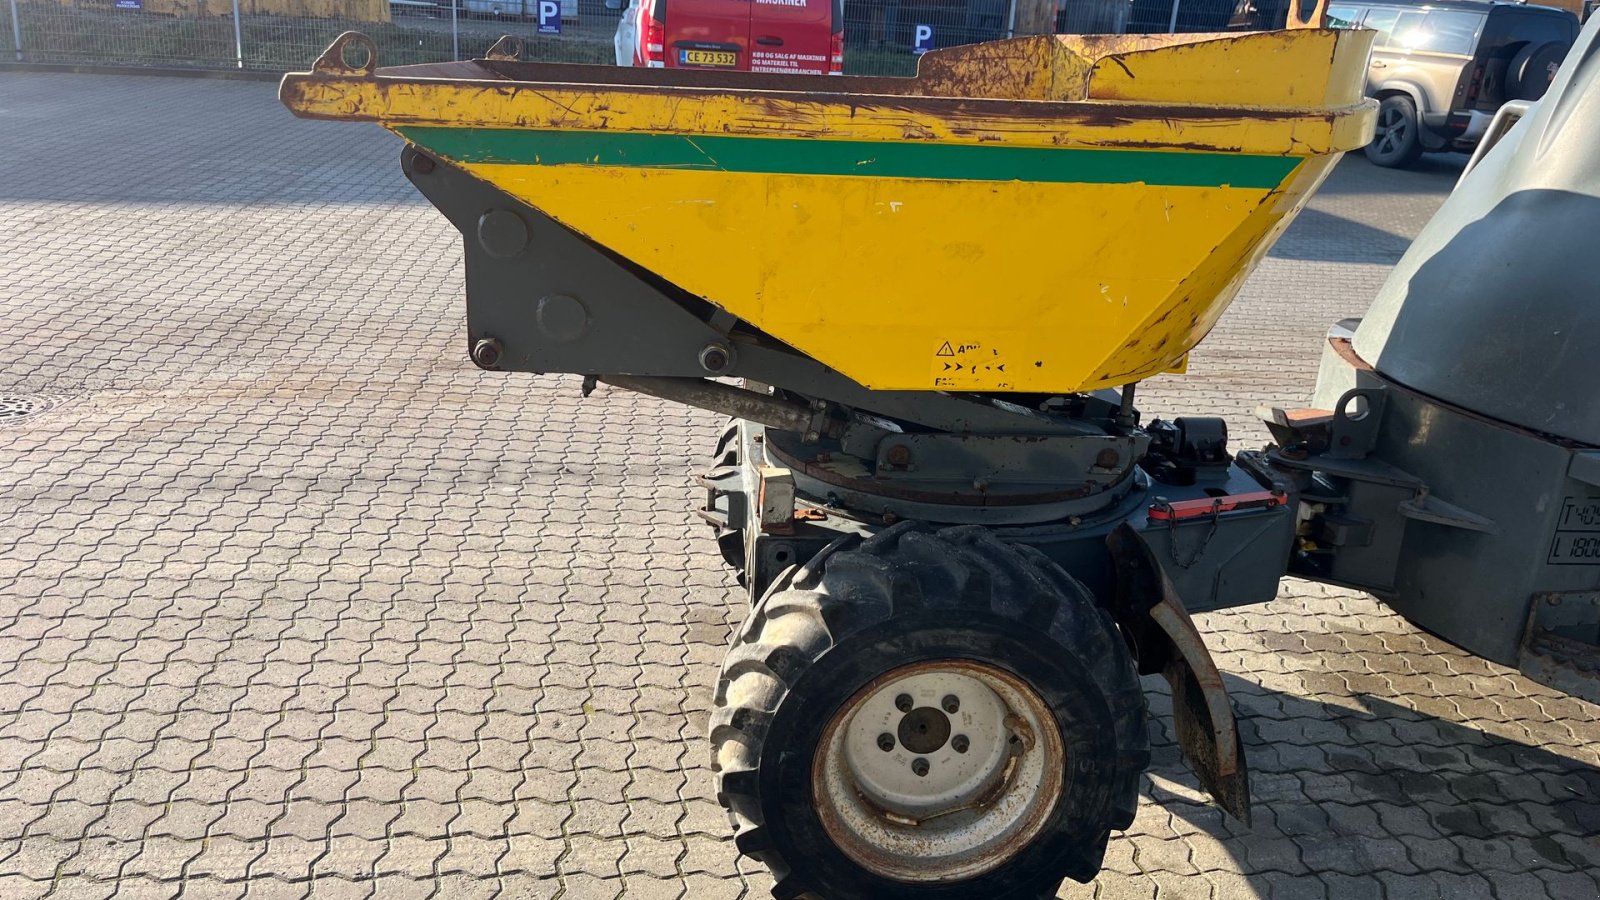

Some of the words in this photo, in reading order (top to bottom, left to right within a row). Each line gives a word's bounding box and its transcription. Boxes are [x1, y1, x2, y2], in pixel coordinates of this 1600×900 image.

[540, 1, 558, 25] P
[915, 25, 931, 48] P
[687, 51, 700, 62] CE
[703, 52, 715, 63] 73
[717, 53, 735, 64] 532
[761, 59, 789, 67] MATERIEL
[1553, 537, 1561, 557] L
